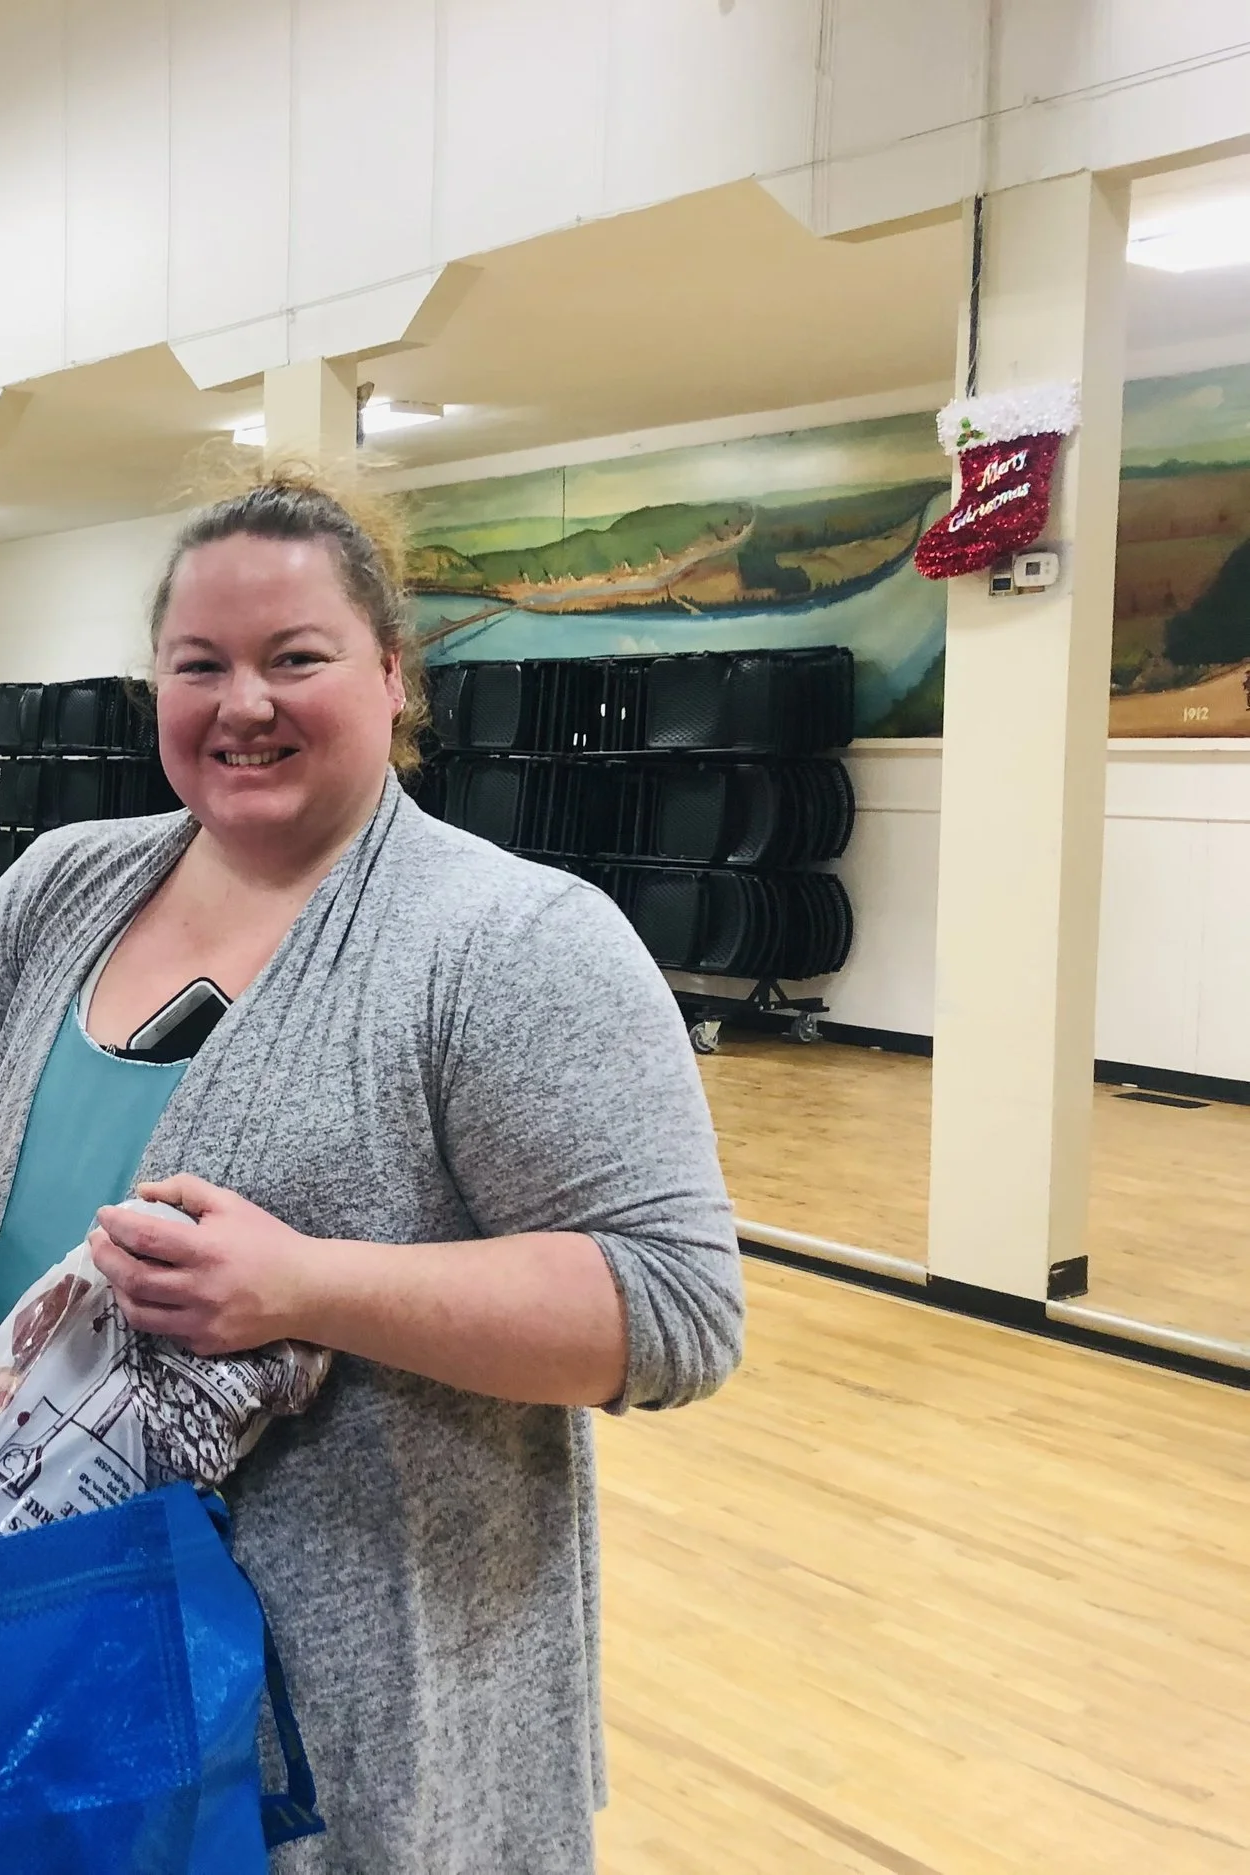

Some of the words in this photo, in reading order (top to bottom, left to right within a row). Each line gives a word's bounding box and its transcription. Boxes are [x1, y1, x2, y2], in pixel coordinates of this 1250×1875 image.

[976, 449, 1028, 492] Merry
[947, 480, 1032, 534] Christmas
[1183, 706, 1209, 723] 1912
